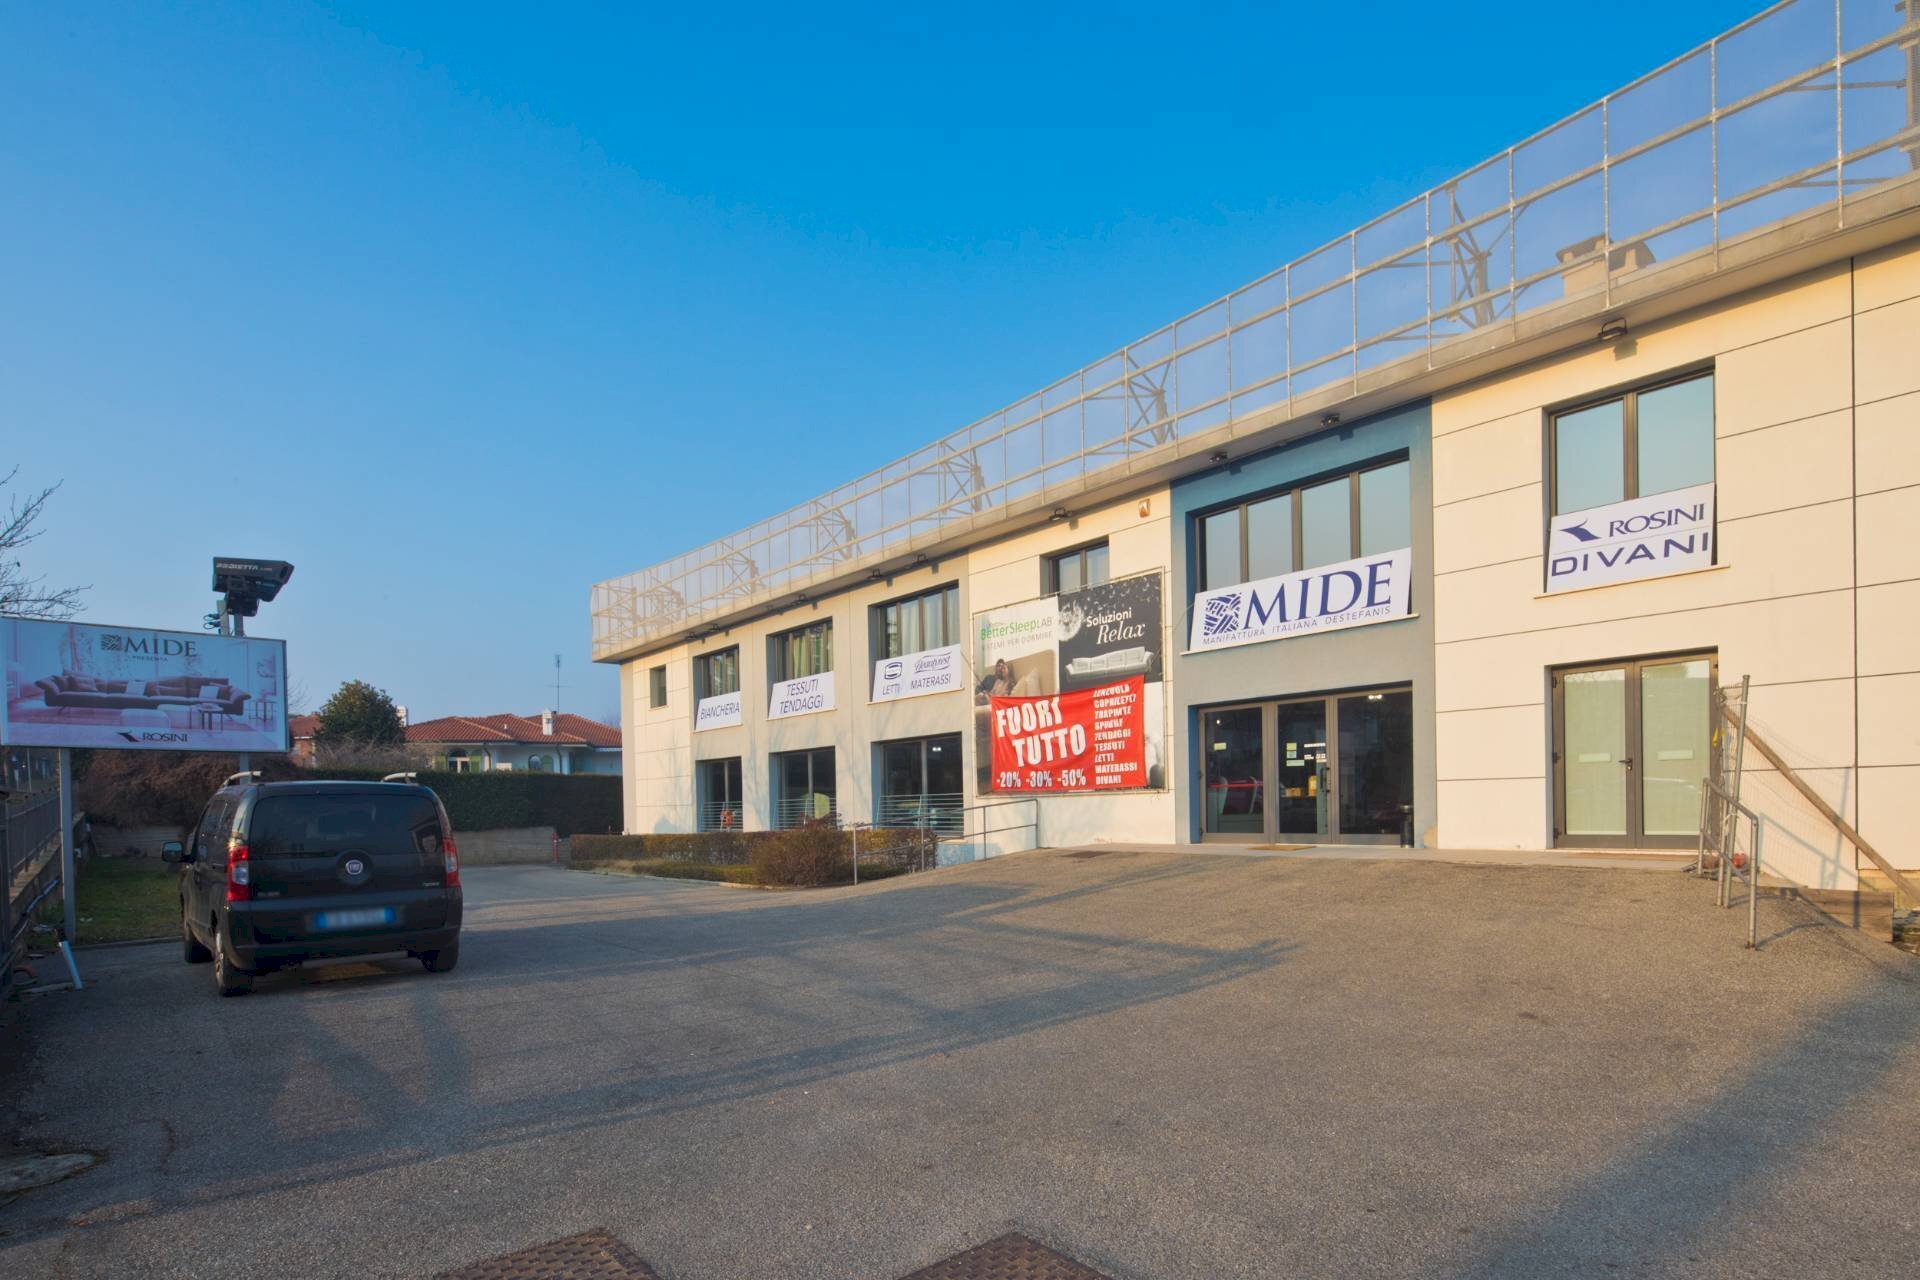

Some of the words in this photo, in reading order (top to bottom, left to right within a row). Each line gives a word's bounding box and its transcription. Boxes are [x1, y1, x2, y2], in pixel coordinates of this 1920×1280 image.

[1608, 503, 1705, 538] ROSINI
[1551, 532, 1709, 577] DIVANI
[1243, 560, 1393, 630] MIDE
[1086, 607, 1132, 628] Soluzioni
[1202, 628, 1265, 645] MANIFATTURA
[1272, 620, 1317, 633] ITALIANA
[1325, 606, 1391, 625] DESTEFANIS
[1096, 620, 1145, 644] Relax
[125, 636, 198, 657] MIDE
[786, 678, 819, 697] TESSUTI
[882, 683, 902, 695] LETTI
[911, 673, 952, 689] MATERASSI
[700, 705, 740, 720] BIANCHERIA
[779, 697, 823, 714] TENDAGGI
[996, 696, 1062, 738] FUORI
[142, 732, 188, 742] ROSINI
[1011, 723, 1087, 768] TUTTO
[1094, 741, 1125, 752] TESSUTI
[1095, 753, 1114, 763] LETTI
[1095, 762, 1138, 773] MATERASSI
[996, 771, 1021, 788] -20%
[1026, 770, 1052, 788] -30%
[1057, 768, 1086, 787] -50%
[1095, 775, 1121, 785] DIVANI
